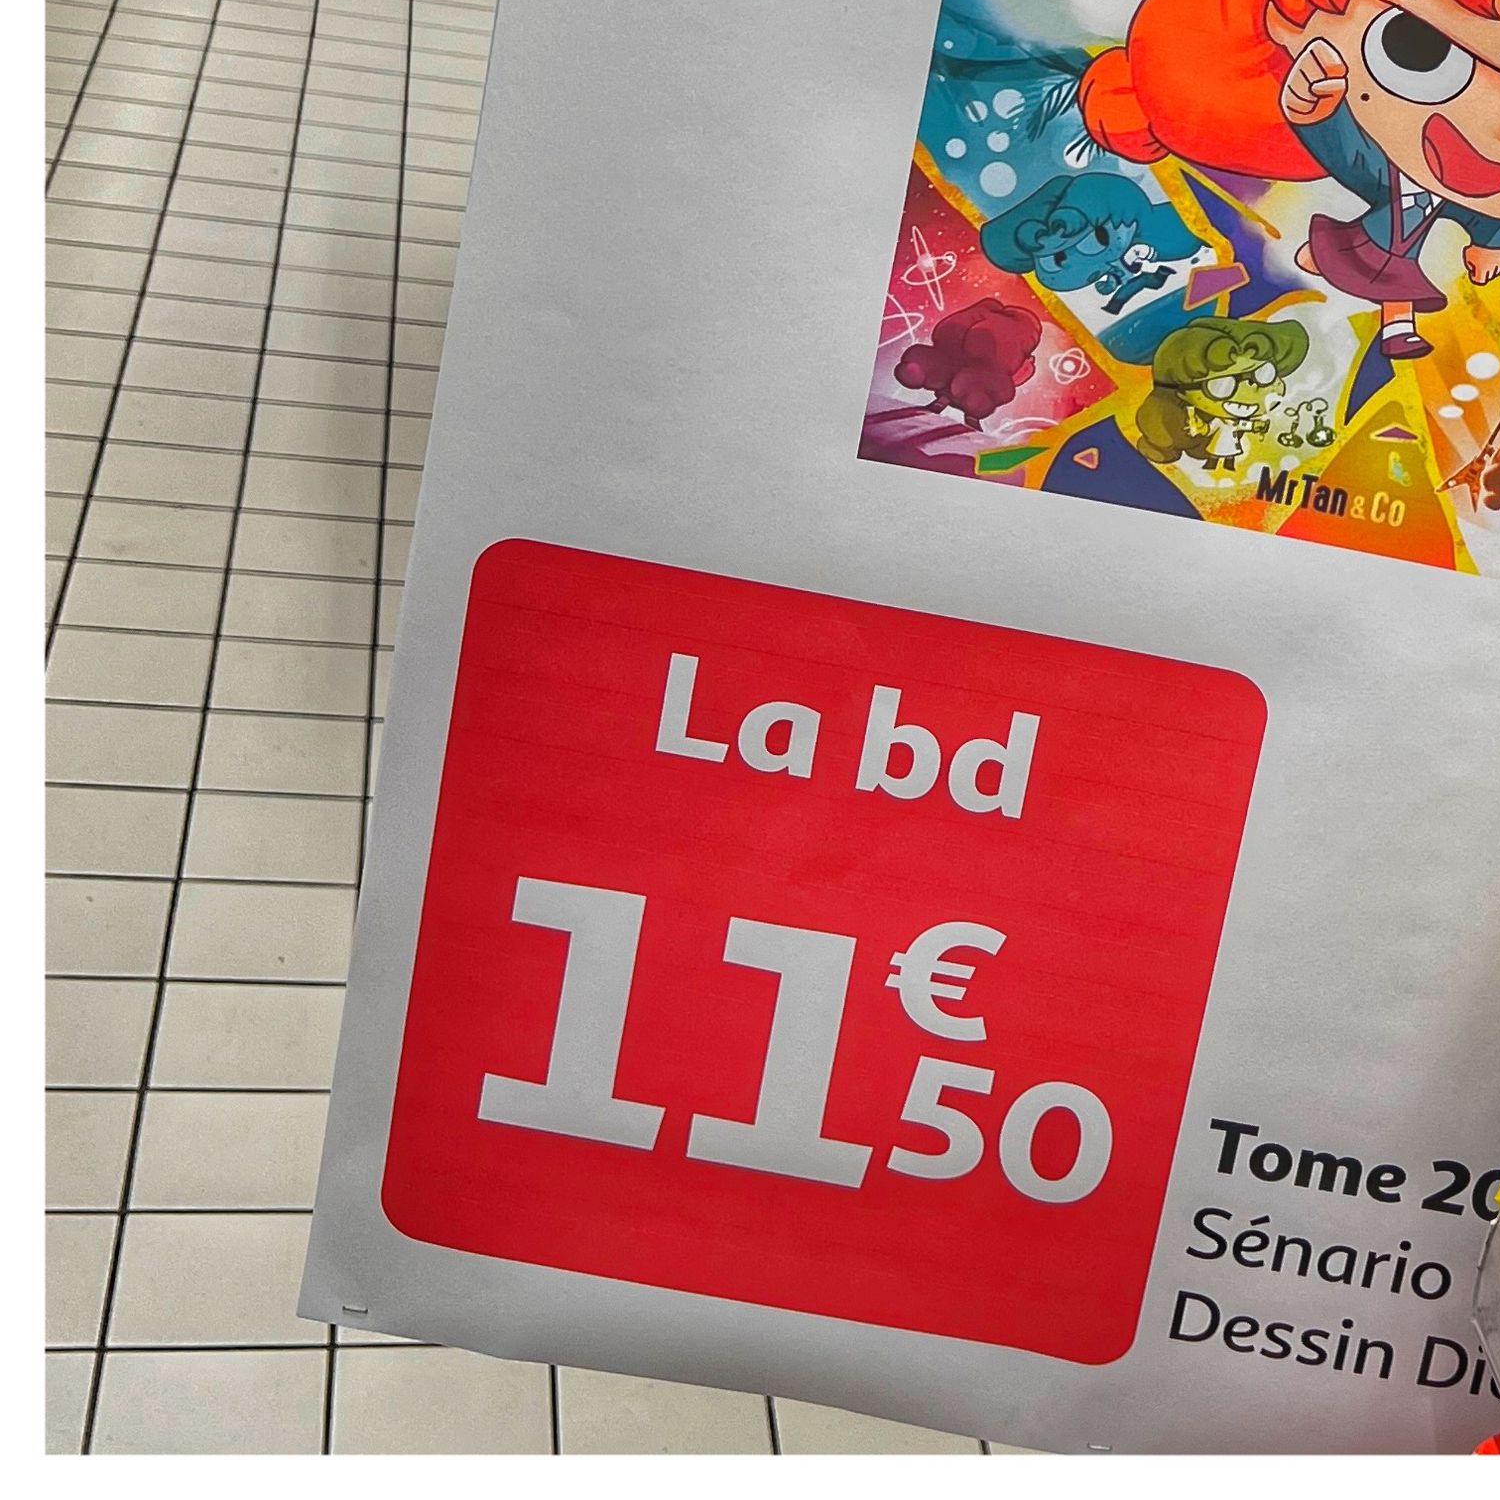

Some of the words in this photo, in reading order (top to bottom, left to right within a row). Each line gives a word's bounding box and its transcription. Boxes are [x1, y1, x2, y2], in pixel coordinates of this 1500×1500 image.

[654, 651, 821, 780] La
[855, 684, 1042, 820] bd
[477, 876, 874, 1189] 11
[887, 1055, 1114, 1206] 50
[1210, 1118, 1407, 1203] Tome
[1185, 1207, 1452, 1301] Sénario
[1169, 1290, 1395, 1380] Dessin
